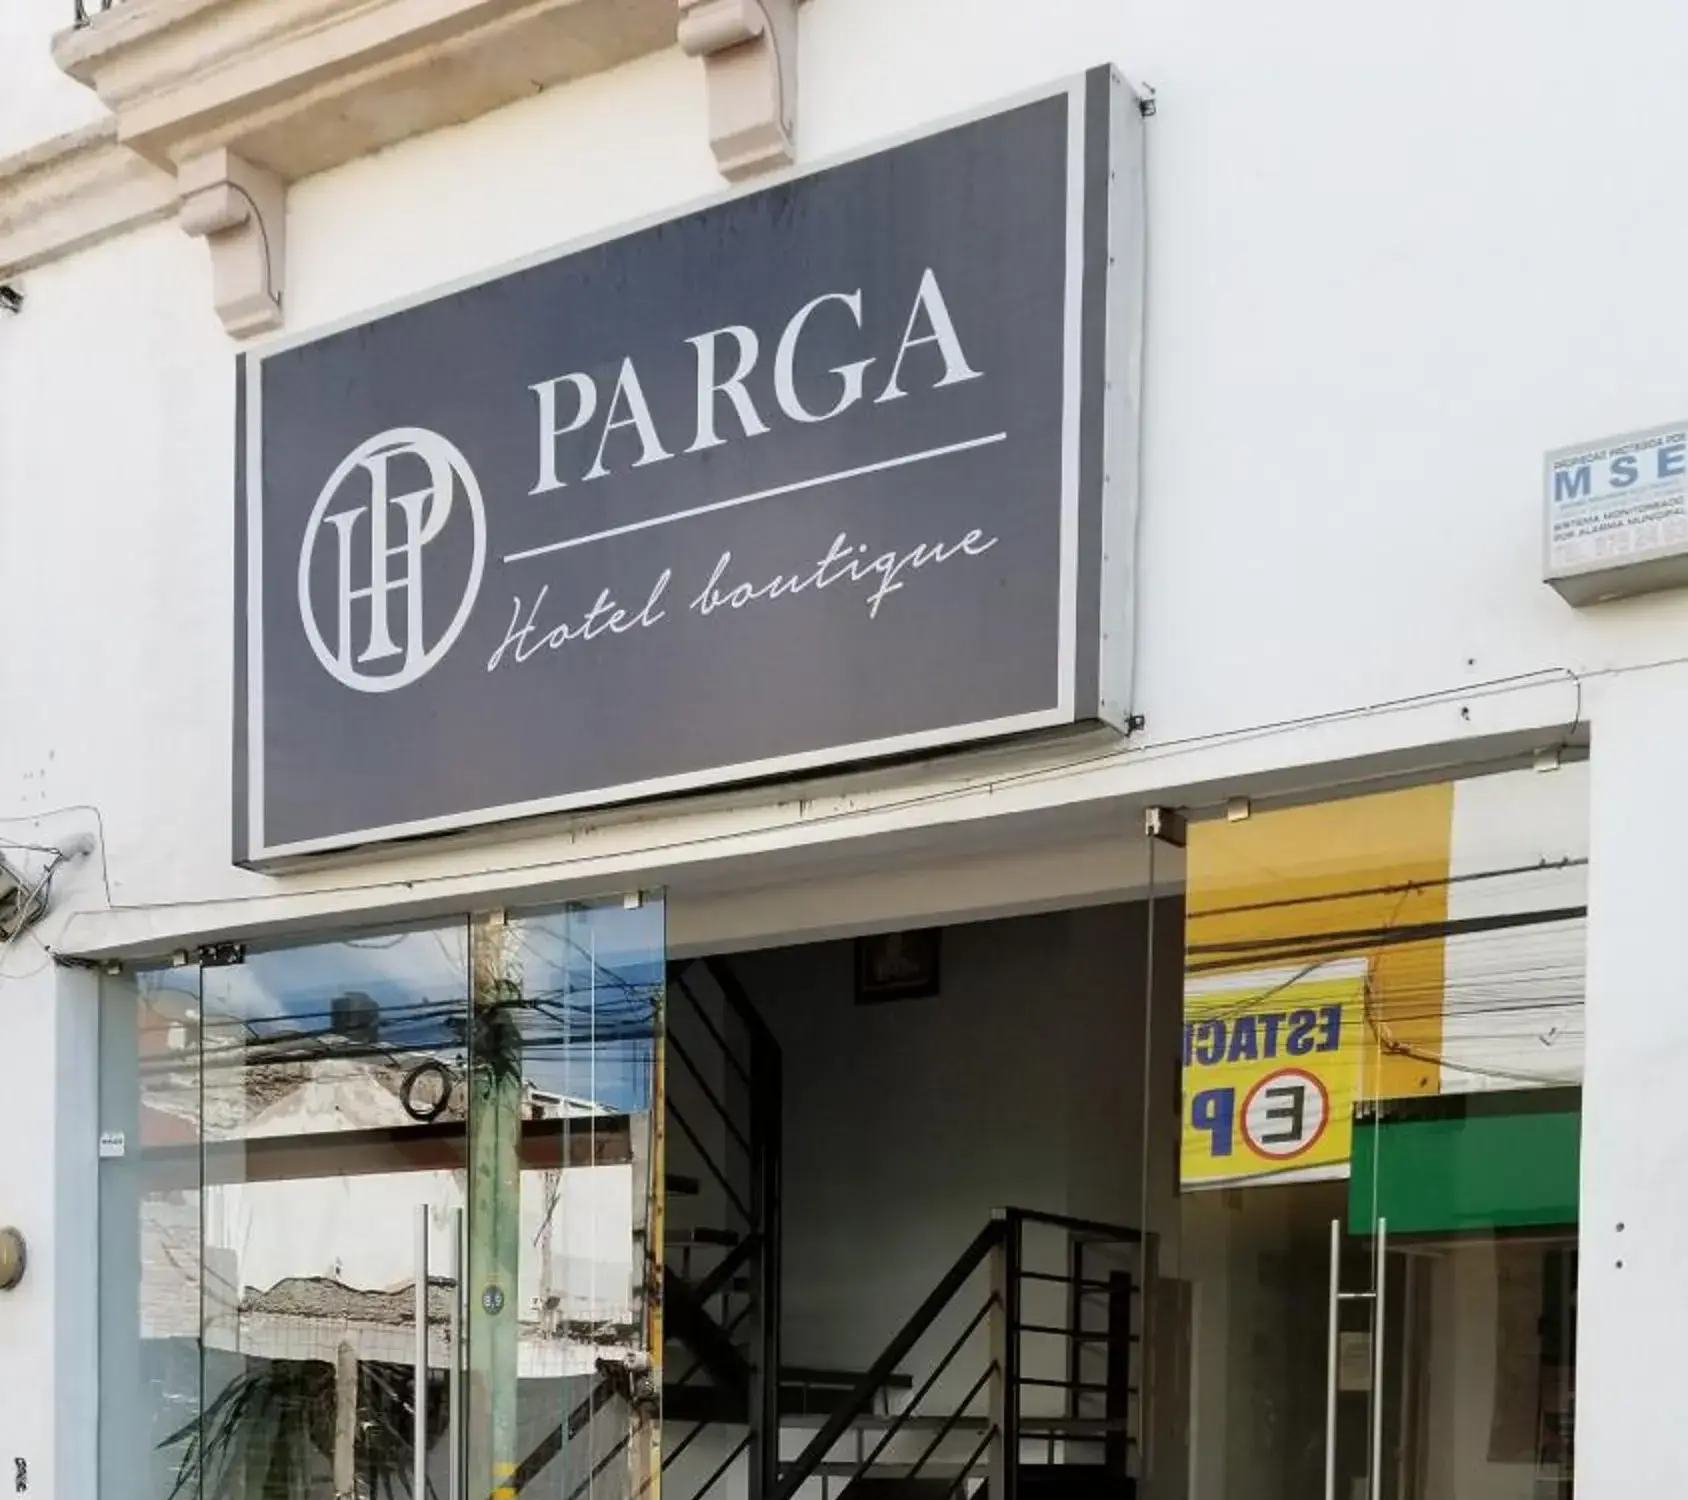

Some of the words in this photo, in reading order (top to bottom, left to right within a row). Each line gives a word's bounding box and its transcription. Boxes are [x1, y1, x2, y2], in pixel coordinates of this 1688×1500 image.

[528, 267, 985, 496] PARGA
[487, 568, 673, 672] Hotel
[690, 528, 1000, 619] boutique
